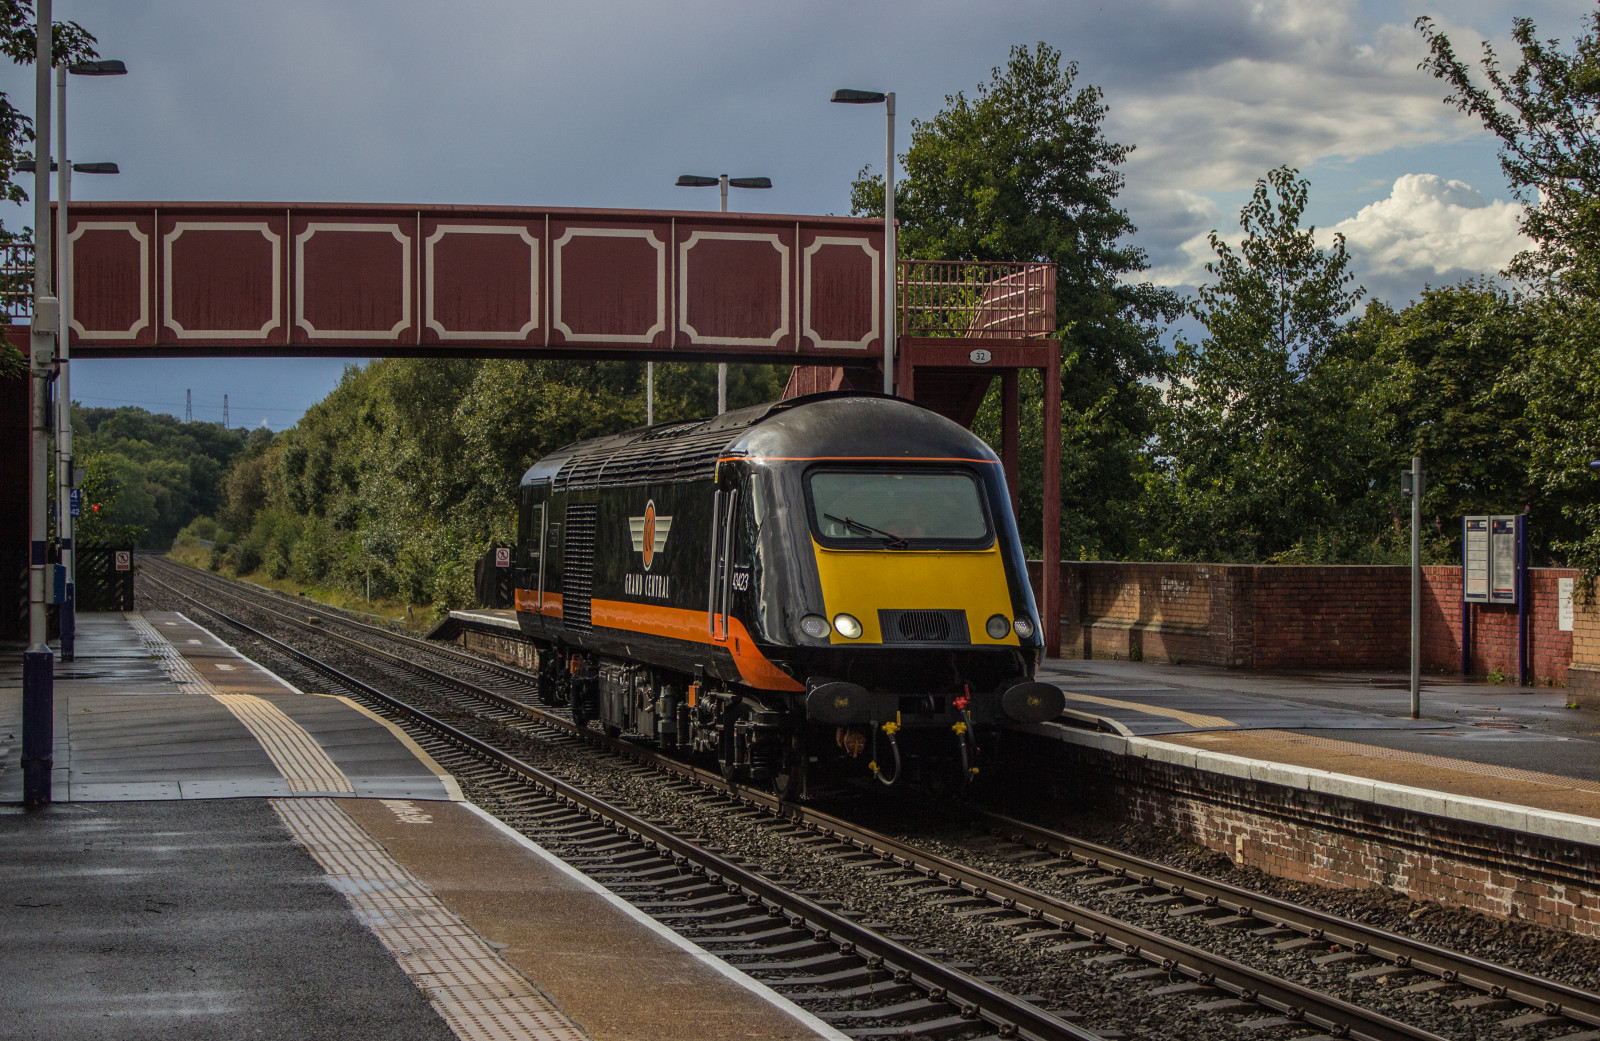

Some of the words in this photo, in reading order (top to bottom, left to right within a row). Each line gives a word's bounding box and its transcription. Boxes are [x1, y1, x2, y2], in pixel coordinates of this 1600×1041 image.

[976, 353, 985, 361] 32
[70, 490, 78, 500] 4
[624, 573, 643, 596] GRAND
[644, 574, 670, 599] CENTRAL
